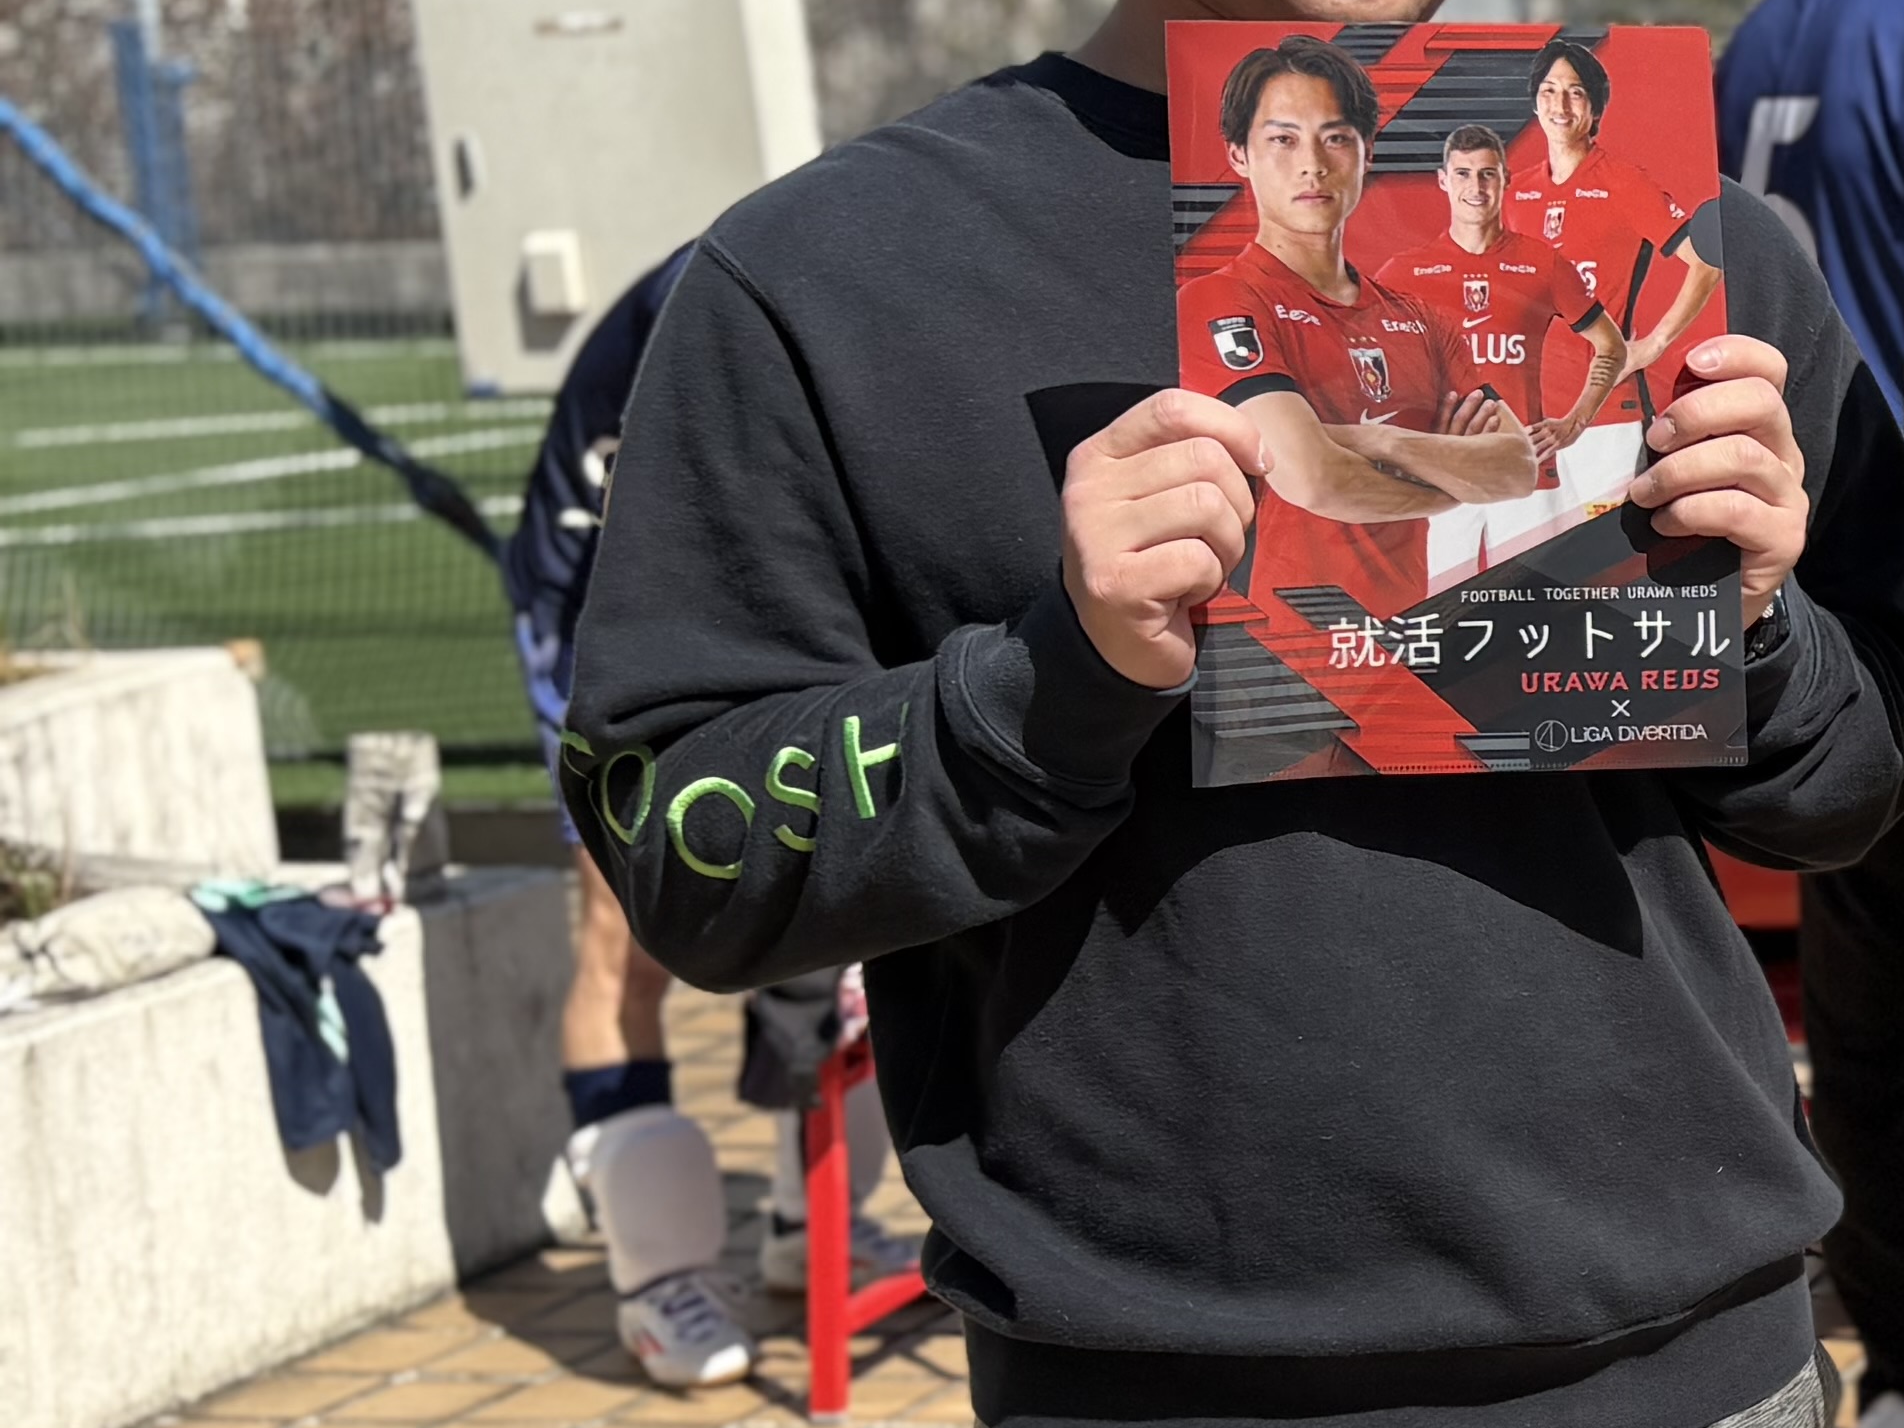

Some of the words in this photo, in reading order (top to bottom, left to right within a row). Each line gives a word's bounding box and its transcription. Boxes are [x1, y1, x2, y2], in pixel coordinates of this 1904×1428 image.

[1461, 332, 1526, 365] LUS
[1460, 590, 1535, 602] FOOTBALL
[1544, 587, 1620, 600] TOGETHER
[1627, 586, 1675, 599] URAWA
[1681, 584, 1718, 598] REDS
[1328, 609, 1731, 669] 就活フットサル
[1521, 671, 1630, 693] URAWA
[1641, 669, 1720, 690] REDS
